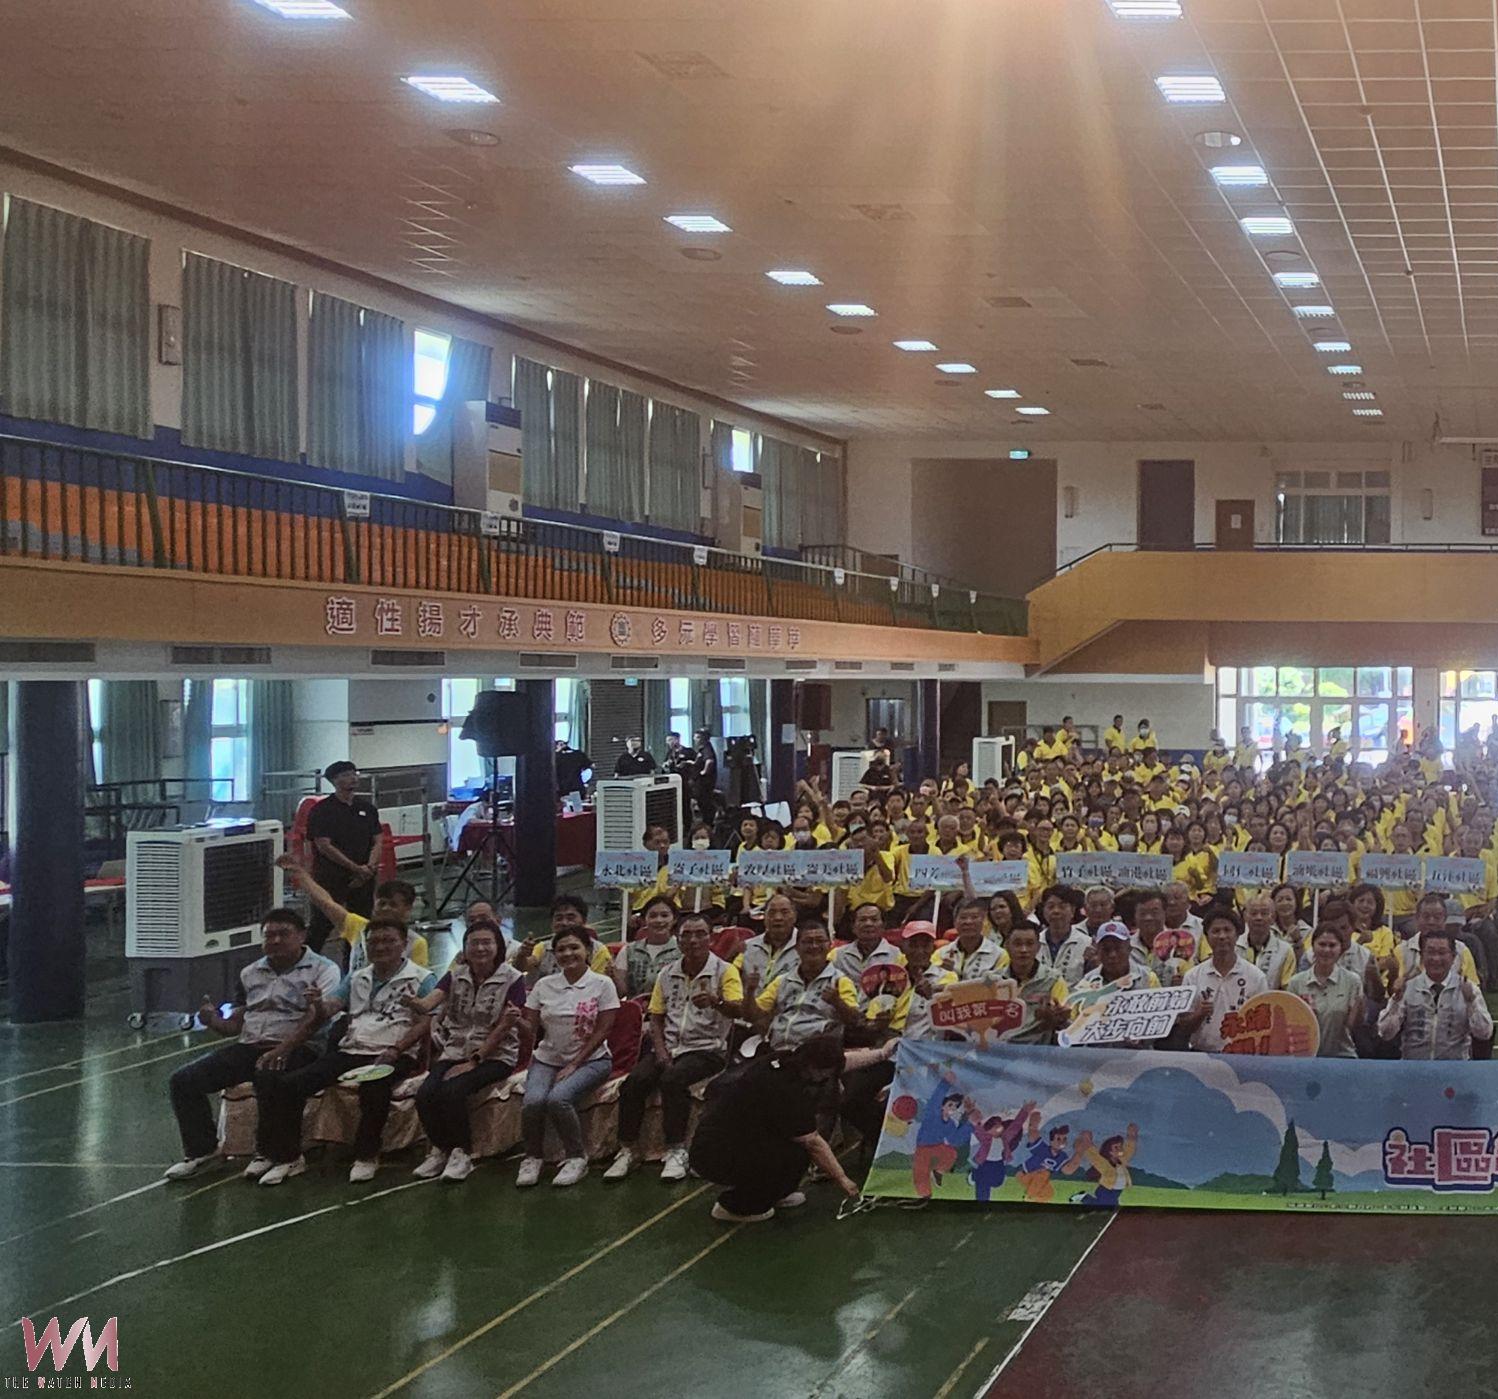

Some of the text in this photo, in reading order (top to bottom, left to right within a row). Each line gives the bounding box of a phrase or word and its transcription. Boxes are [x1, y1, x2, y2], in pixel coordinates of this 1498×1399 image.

[326, 597, 586, 642] 適性揚才承典範
[939, 1002, 1019, 1023] 叫我第一名
[1081, 1014, 1171, 1042] 大步向前
